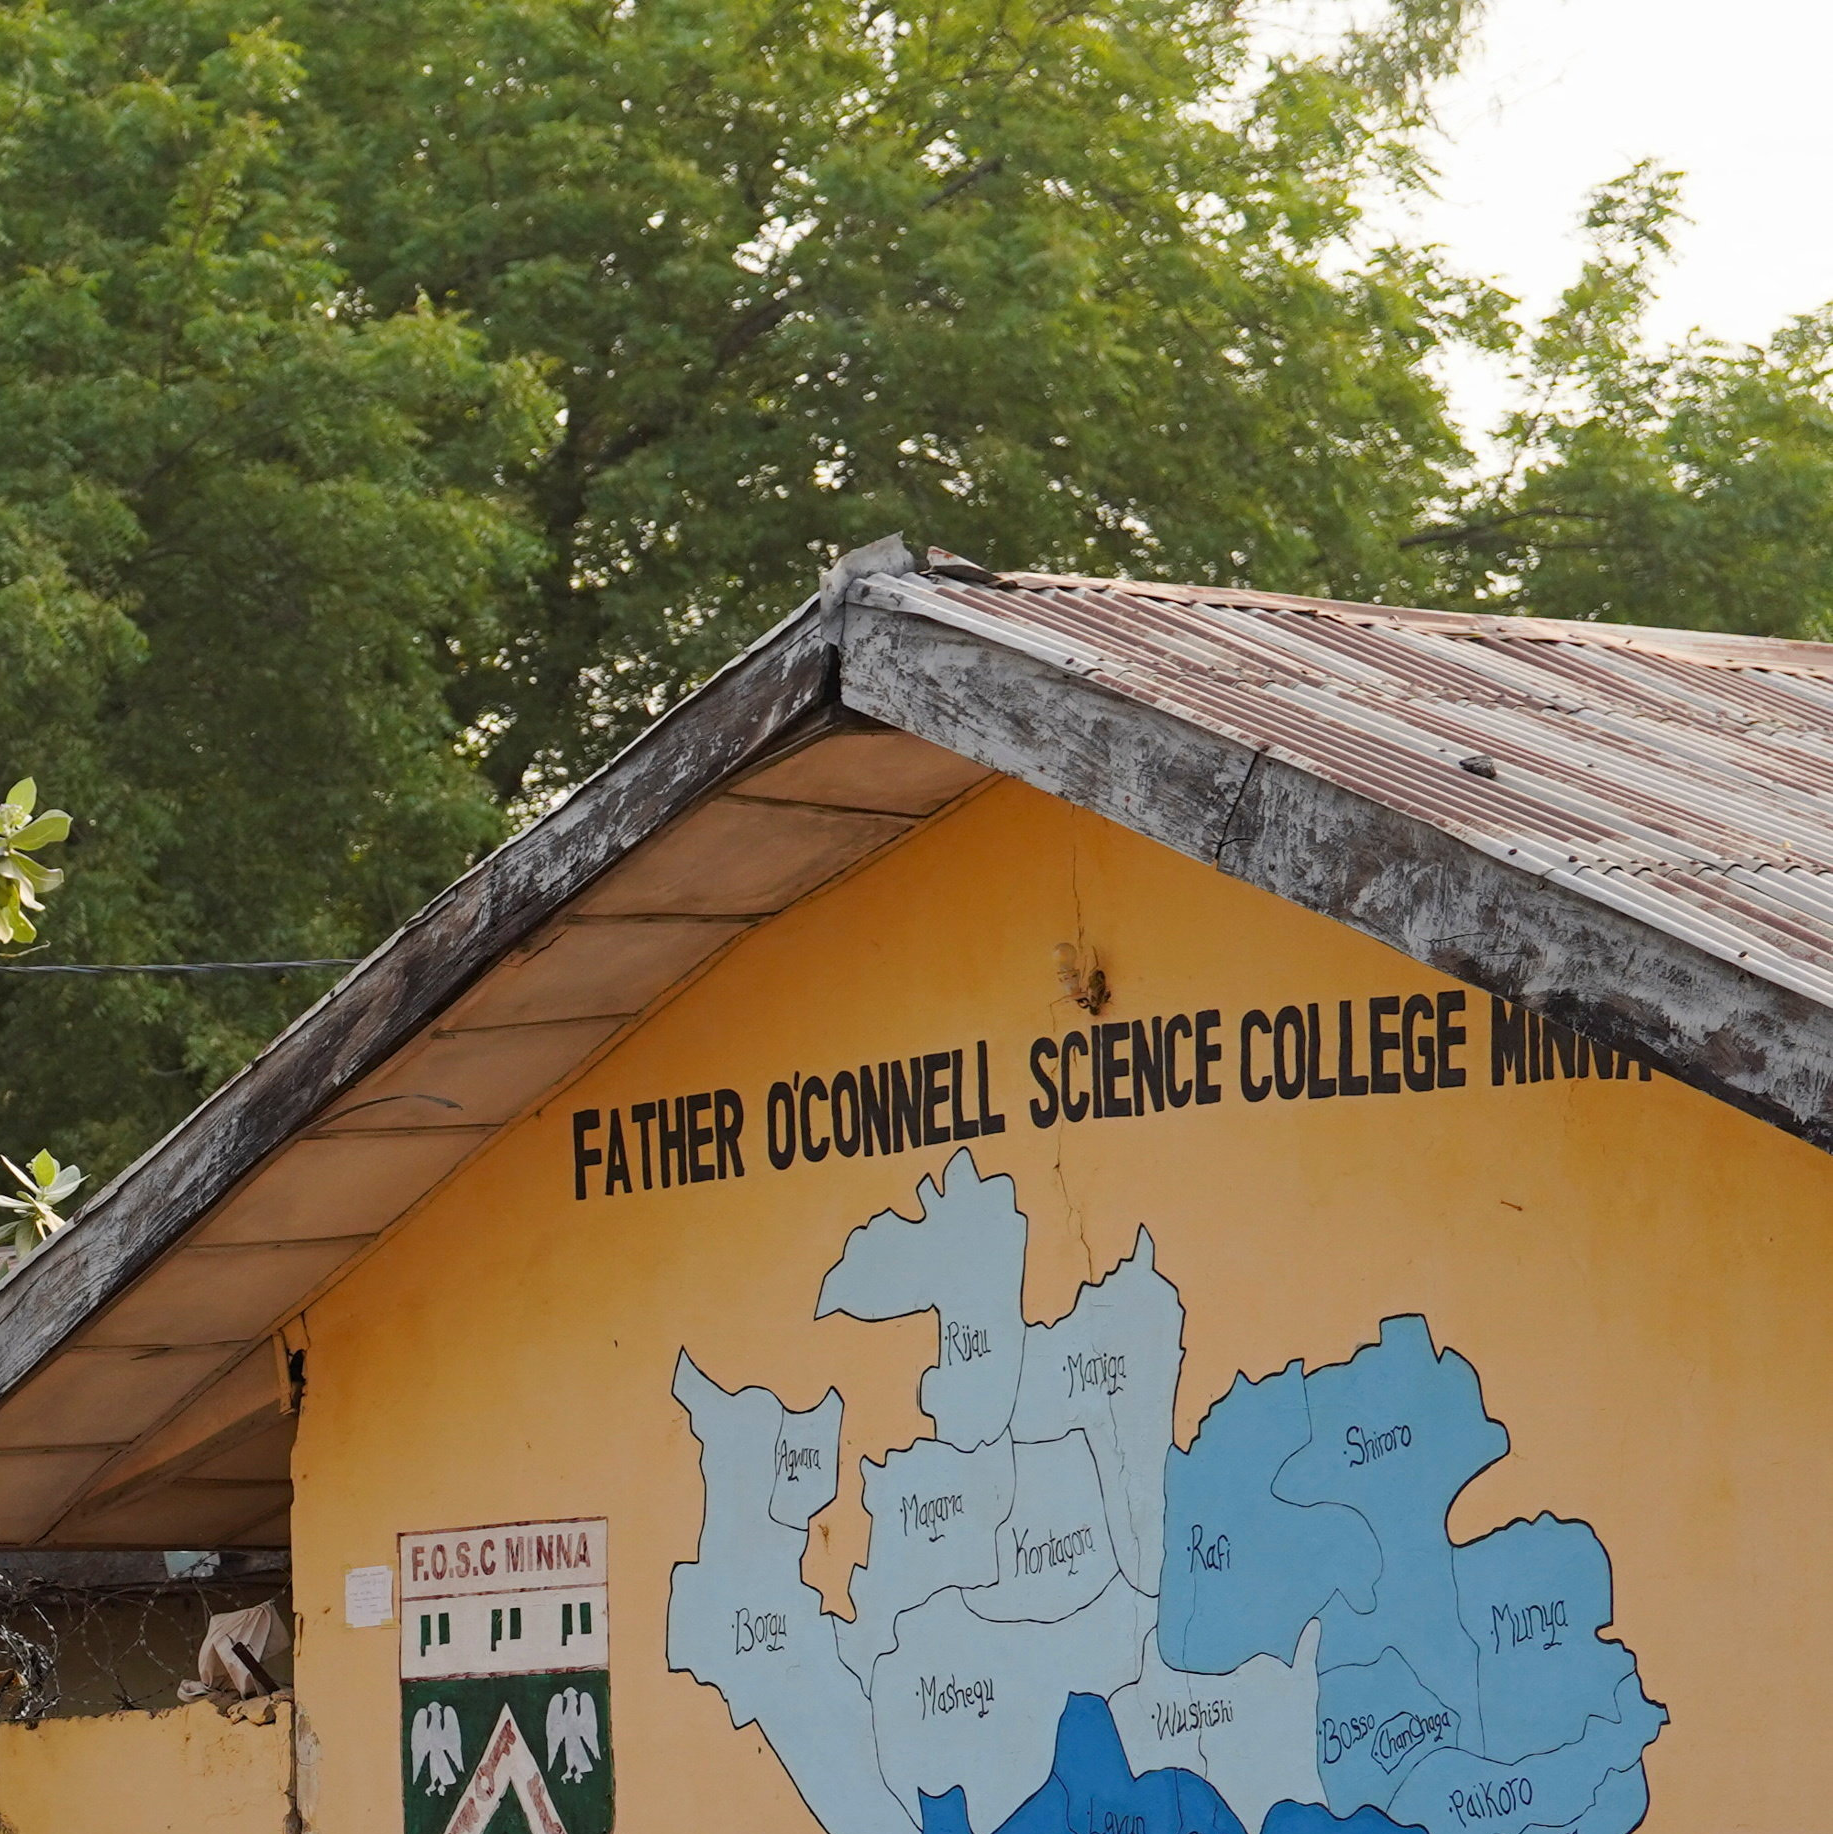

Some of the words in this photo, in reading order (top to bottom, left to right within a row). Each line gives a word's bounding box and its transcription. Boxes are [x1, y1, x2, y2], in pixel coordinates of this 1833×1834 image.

[573, 1090, 745, 1201] FATHER
[765, 1039, 1005, 1171] O'CONNELL
[1029, 1010, 1222, 1131] SCIENCE
[1239, 990, 1467, 1103] COLLEGE
[947, 1321, 992, 1366] Rijau
[1067, 1352, 1127, 1398] Mariga
[1346, 1423, 1412, 1468] Shiroro
[902, 1494, 964, 1543] Magama
[411, 1539, 497, 1582] F.O.S.C
[505, 1532, 591, 1573] MINNA
[1012, 1527, 1096, 1578] Kontagora
[1189, 1525, 1231, 1573] Rafi
[735, 1608, 787, 1655] Borgu
[1492, 1600, 1568, 1654] Munya
